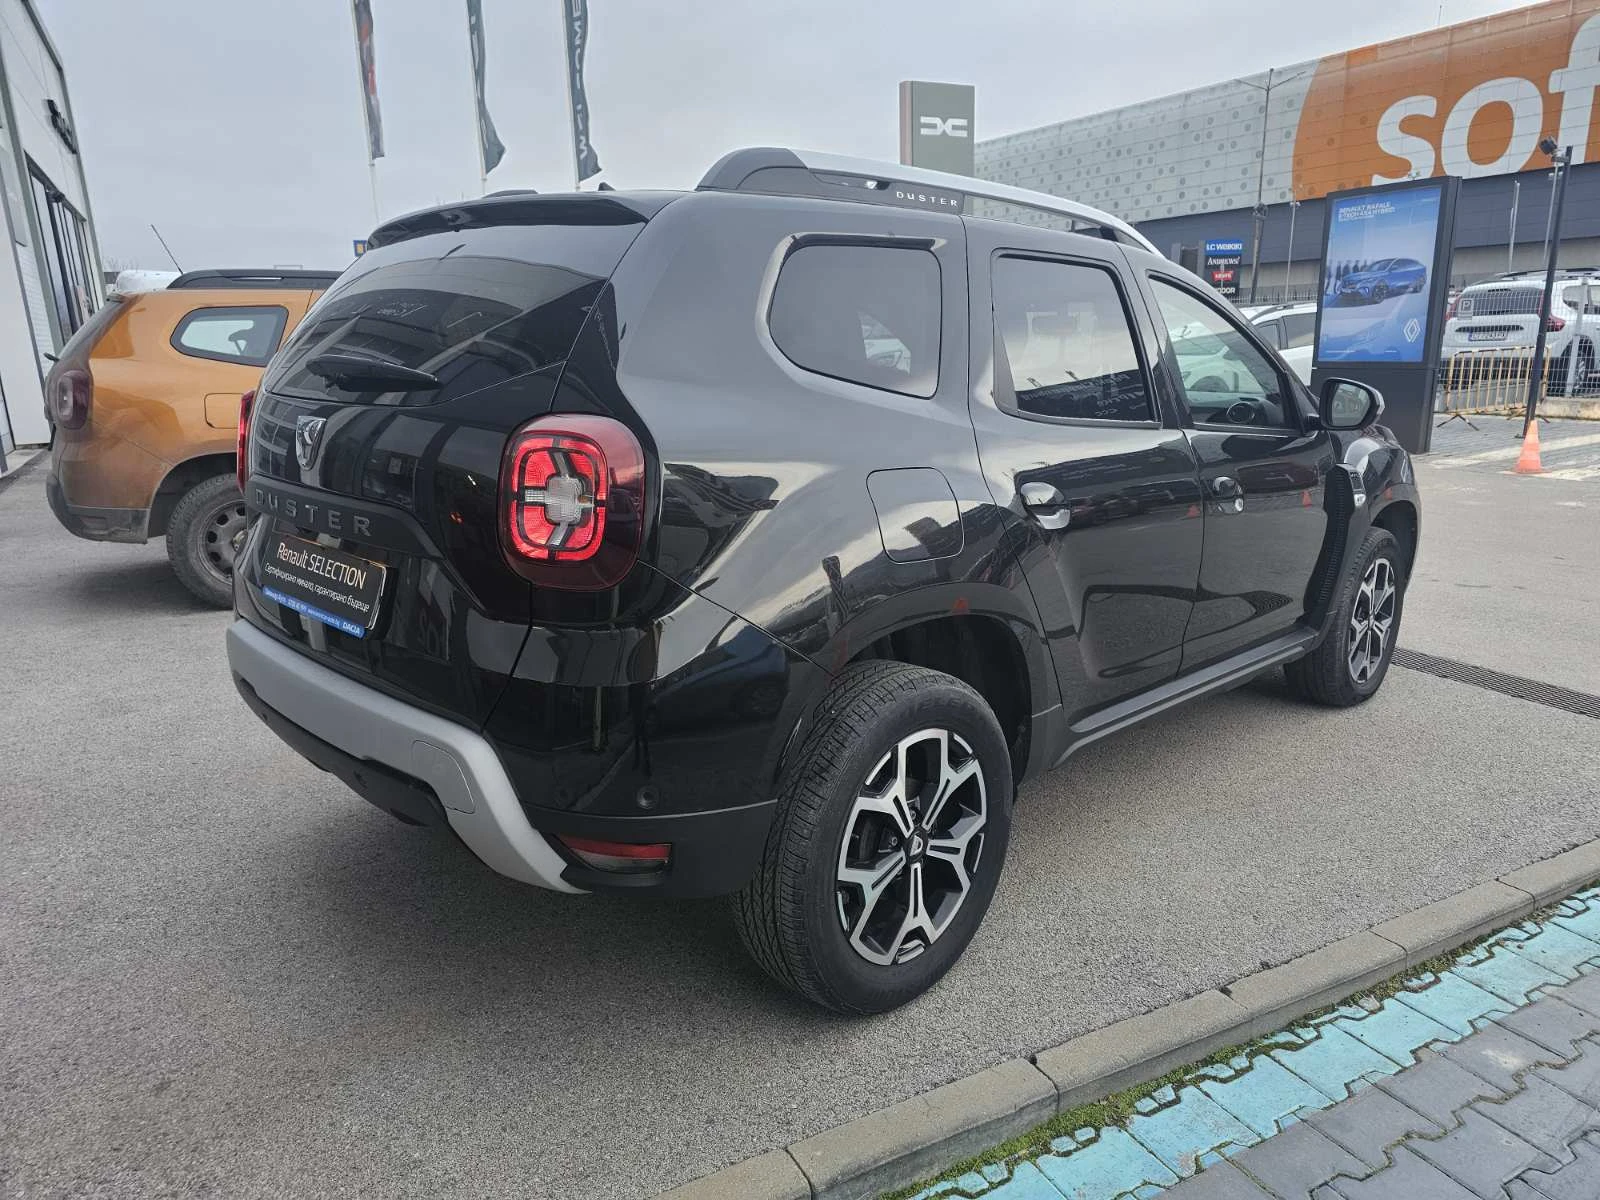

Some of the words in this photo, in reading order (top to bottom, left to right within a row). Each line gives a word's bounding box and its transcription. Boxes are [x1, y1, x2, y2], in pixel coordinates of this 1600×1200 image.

[896, 191, 958, 207] DUSTER
[1462, 300, 1471, 310] P
[255, 488, 372, 537] DUSTER
[276, 542, 309, 569] Renault
[308, 553, 367, 590] SELECTION
